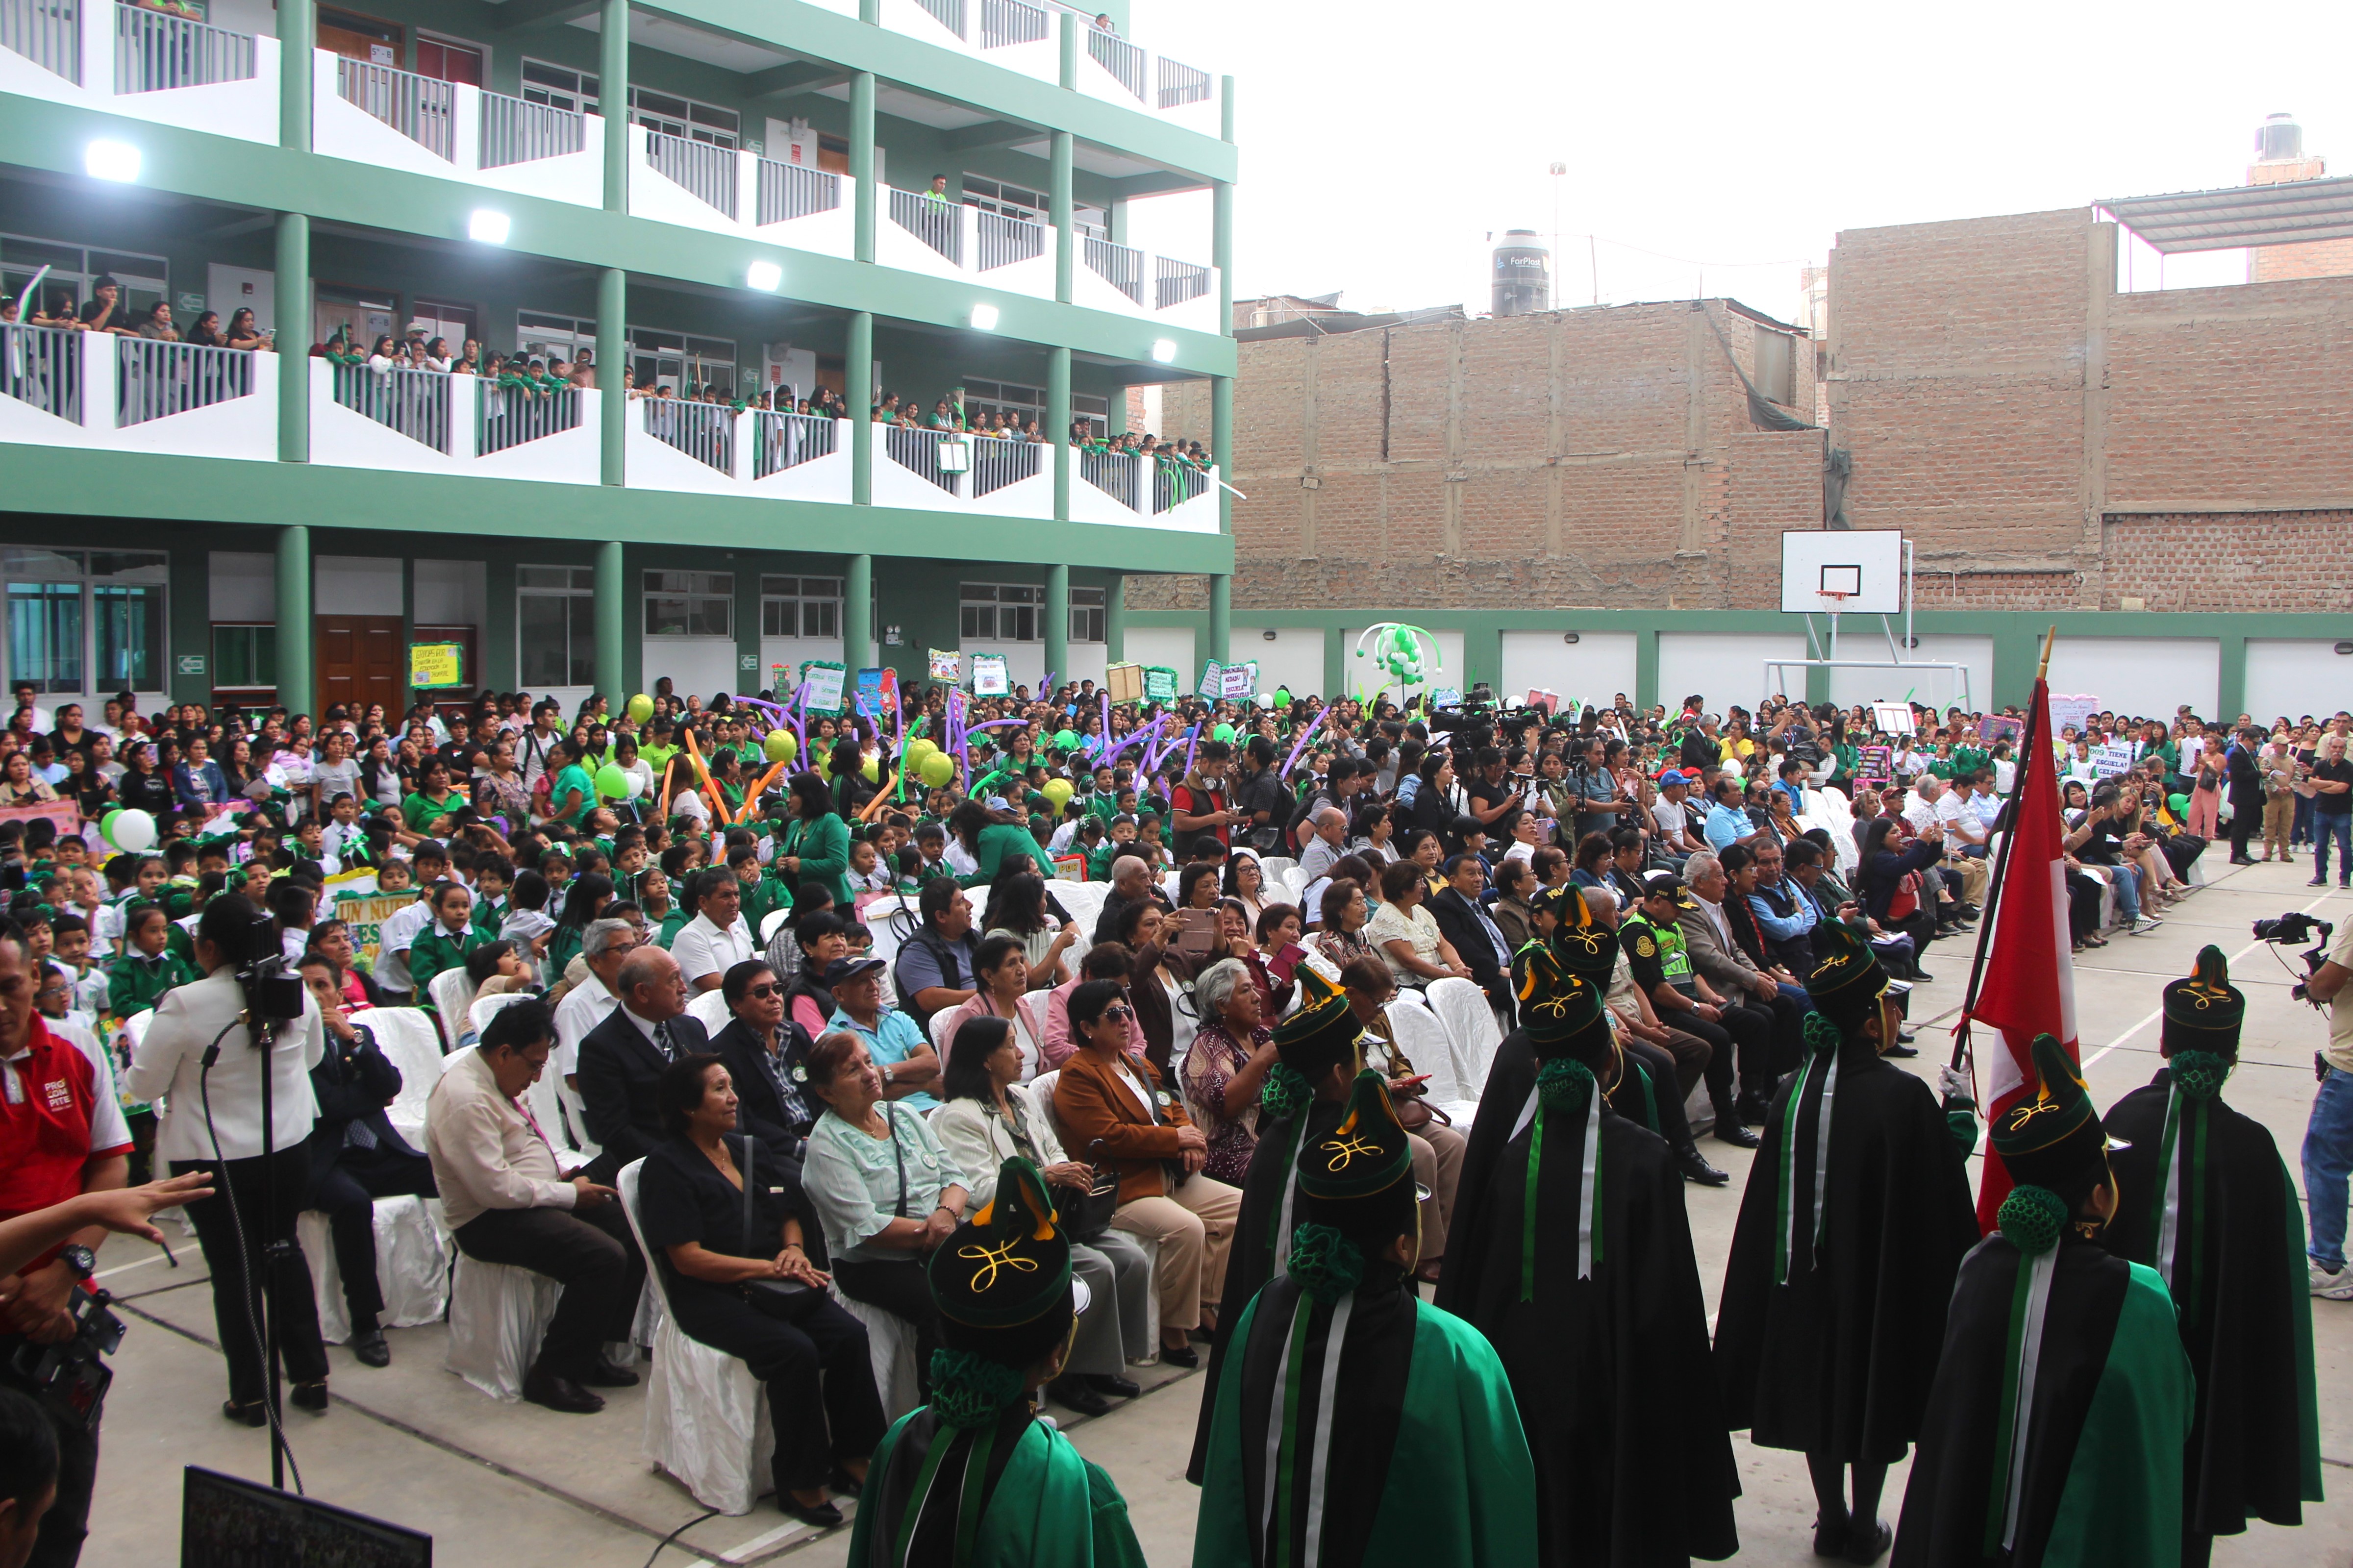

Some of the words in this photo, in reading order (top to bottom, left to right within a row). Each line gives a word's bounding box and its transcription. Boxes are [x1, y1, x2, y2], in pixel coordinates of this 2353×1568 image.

[386, 50, 392, 59] B
[1510, 256, 1541, 266] FarPlast
[384, 318, 389, 326] B
[2108, 750, 2128, 759] TIENE
[2096, 758, 2128, 769] ESCUELA!
[1059, 862, 1078, 874] POR
[338, 902, 363, 922] UN
[45, 1078, 66, 1092] PRO
[47, 1087, 68, 1099] COM
[50, 1095, 72, 1107] PITE
